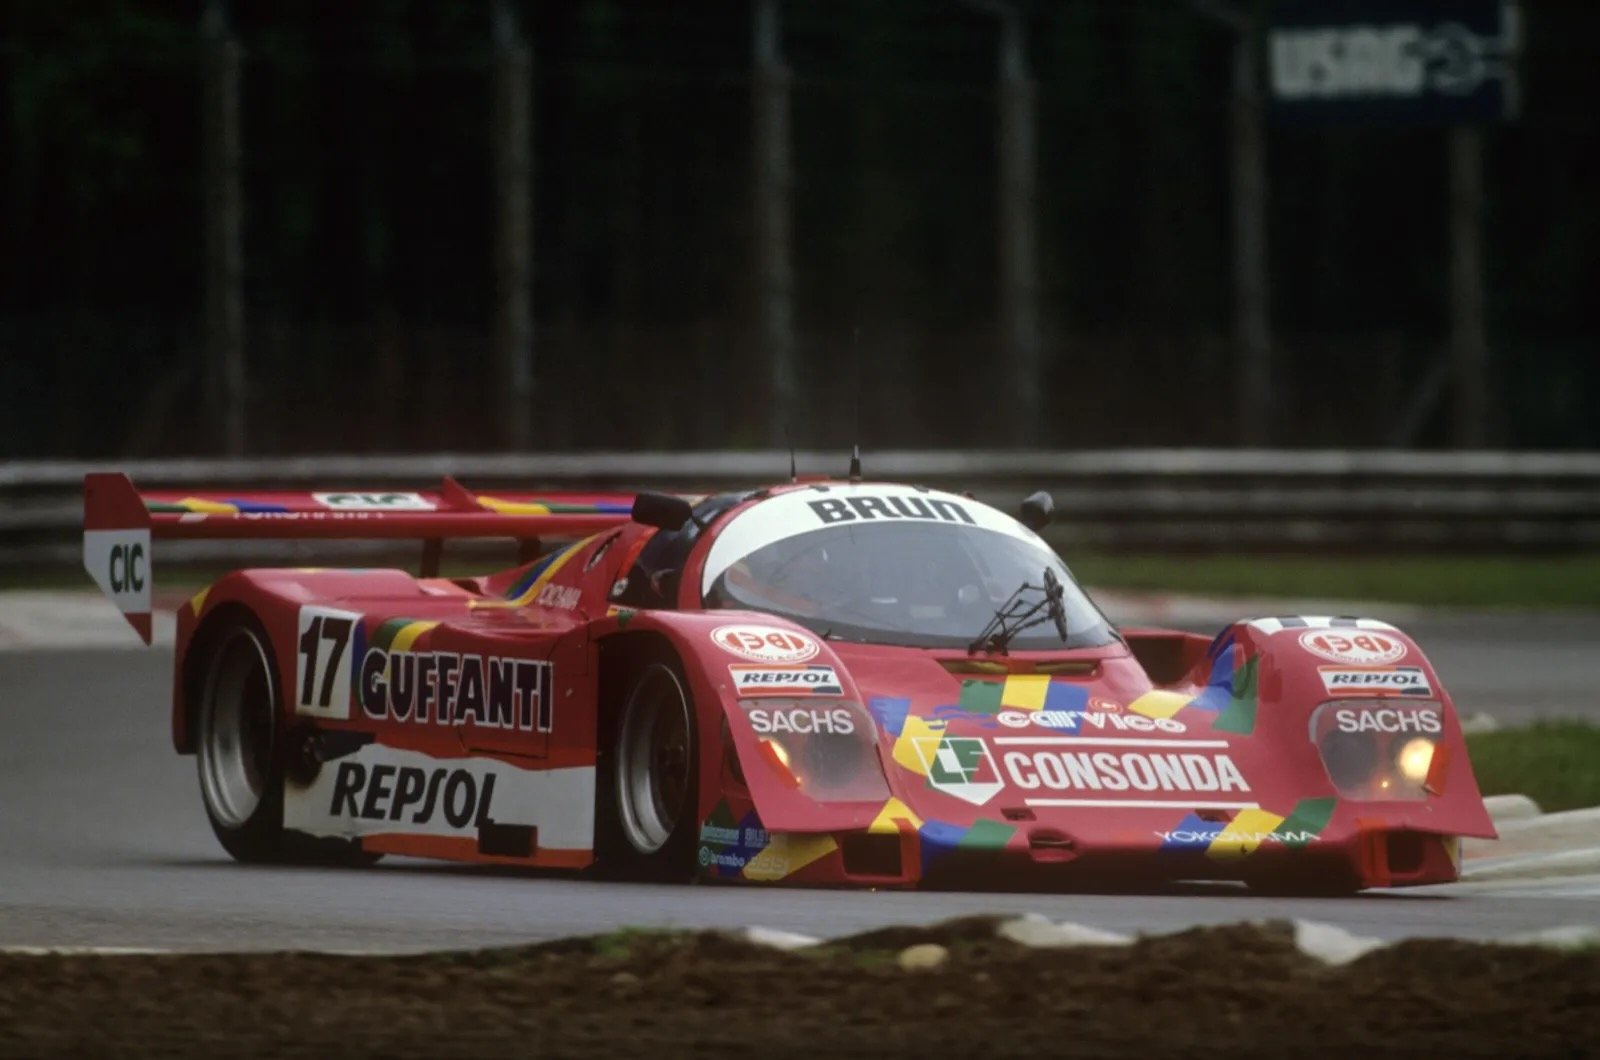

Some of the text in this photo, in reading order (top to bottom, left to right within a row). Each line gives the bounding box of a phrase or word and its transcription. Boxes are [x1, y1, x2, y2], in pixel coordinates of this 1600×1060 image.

[807, 494, 976, 525] BRUN
[109, 542, 145, 594] CIC
[300, 617, 351, 708] 17
[743, 672, 832, 684] REPSOL
[361, 648, 555, 733] GUFFANTI
[1331, 673, 1420, 685] REPSOL
[749, 709, 855, 735] SACHS
[1336, 709, 1442, 733] SACHS
[1003, 752, 1252, 793] CONSONDA
[329, 762, 497, 829] REPSOL
[1154, 830, 1322, 843] YOKOHAMA
